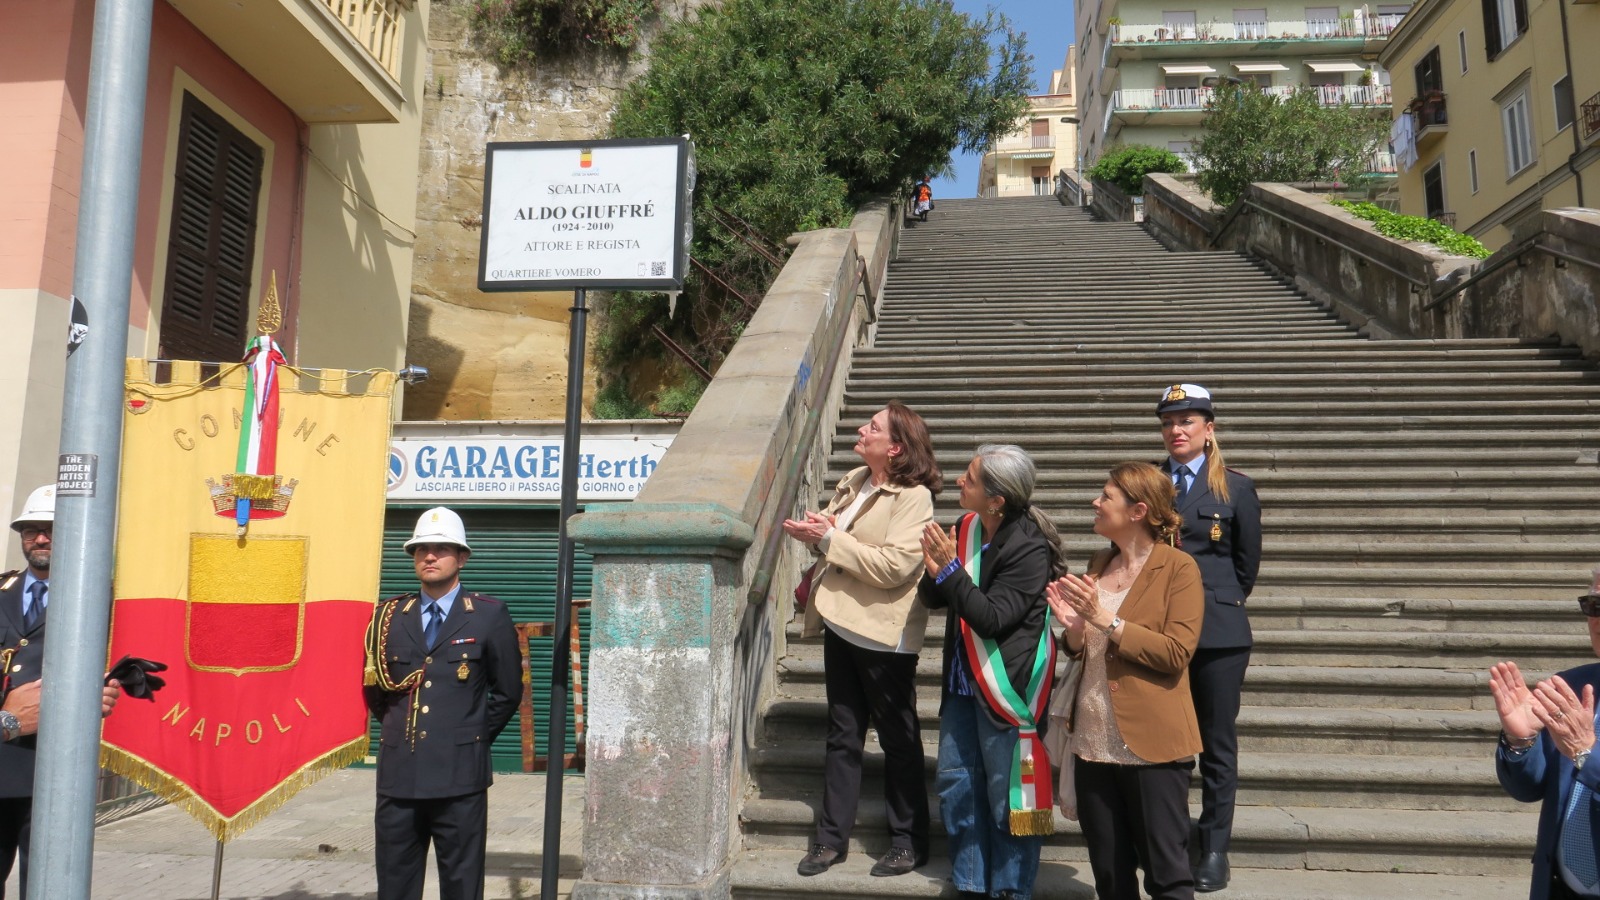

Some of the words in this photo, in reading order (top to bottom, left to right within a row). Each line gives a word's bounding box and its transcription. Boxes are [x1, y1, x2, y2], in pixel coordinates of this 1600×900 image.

[547, 183, 621, 195] SCALINATA
[513, 206, 567, 221] ALDO
[571, 200, 655, 220] GIUFFRÉ
[524, 241, 572, 252] ATTORE
[576, 241, 584, 251] E
[587, 239, 641, 250] REGISTA
[491, 269, 552, 280] QUARTIERE
[555, 268, 602, 278] VOMERO
[65, 456, 83, 464] THE
[415, 445, 561, 479] GARAGE
[59, 464, 91, 472] HIDDEN
[59, 472, 90, 481] ARTIST
[57, 481, 94, 489] PROJECT
[415, 481, 466, 492] LASCIARE
[469, 481, 507, 492] LIBERO
[509, 482, 515, 491] il
[518, 481, 579, 492] PASSAG
[582, 482, 626, 492] GIORNO
[628, 484, 634, 492] e
[161, 697, 311, 747] NAPOLI
